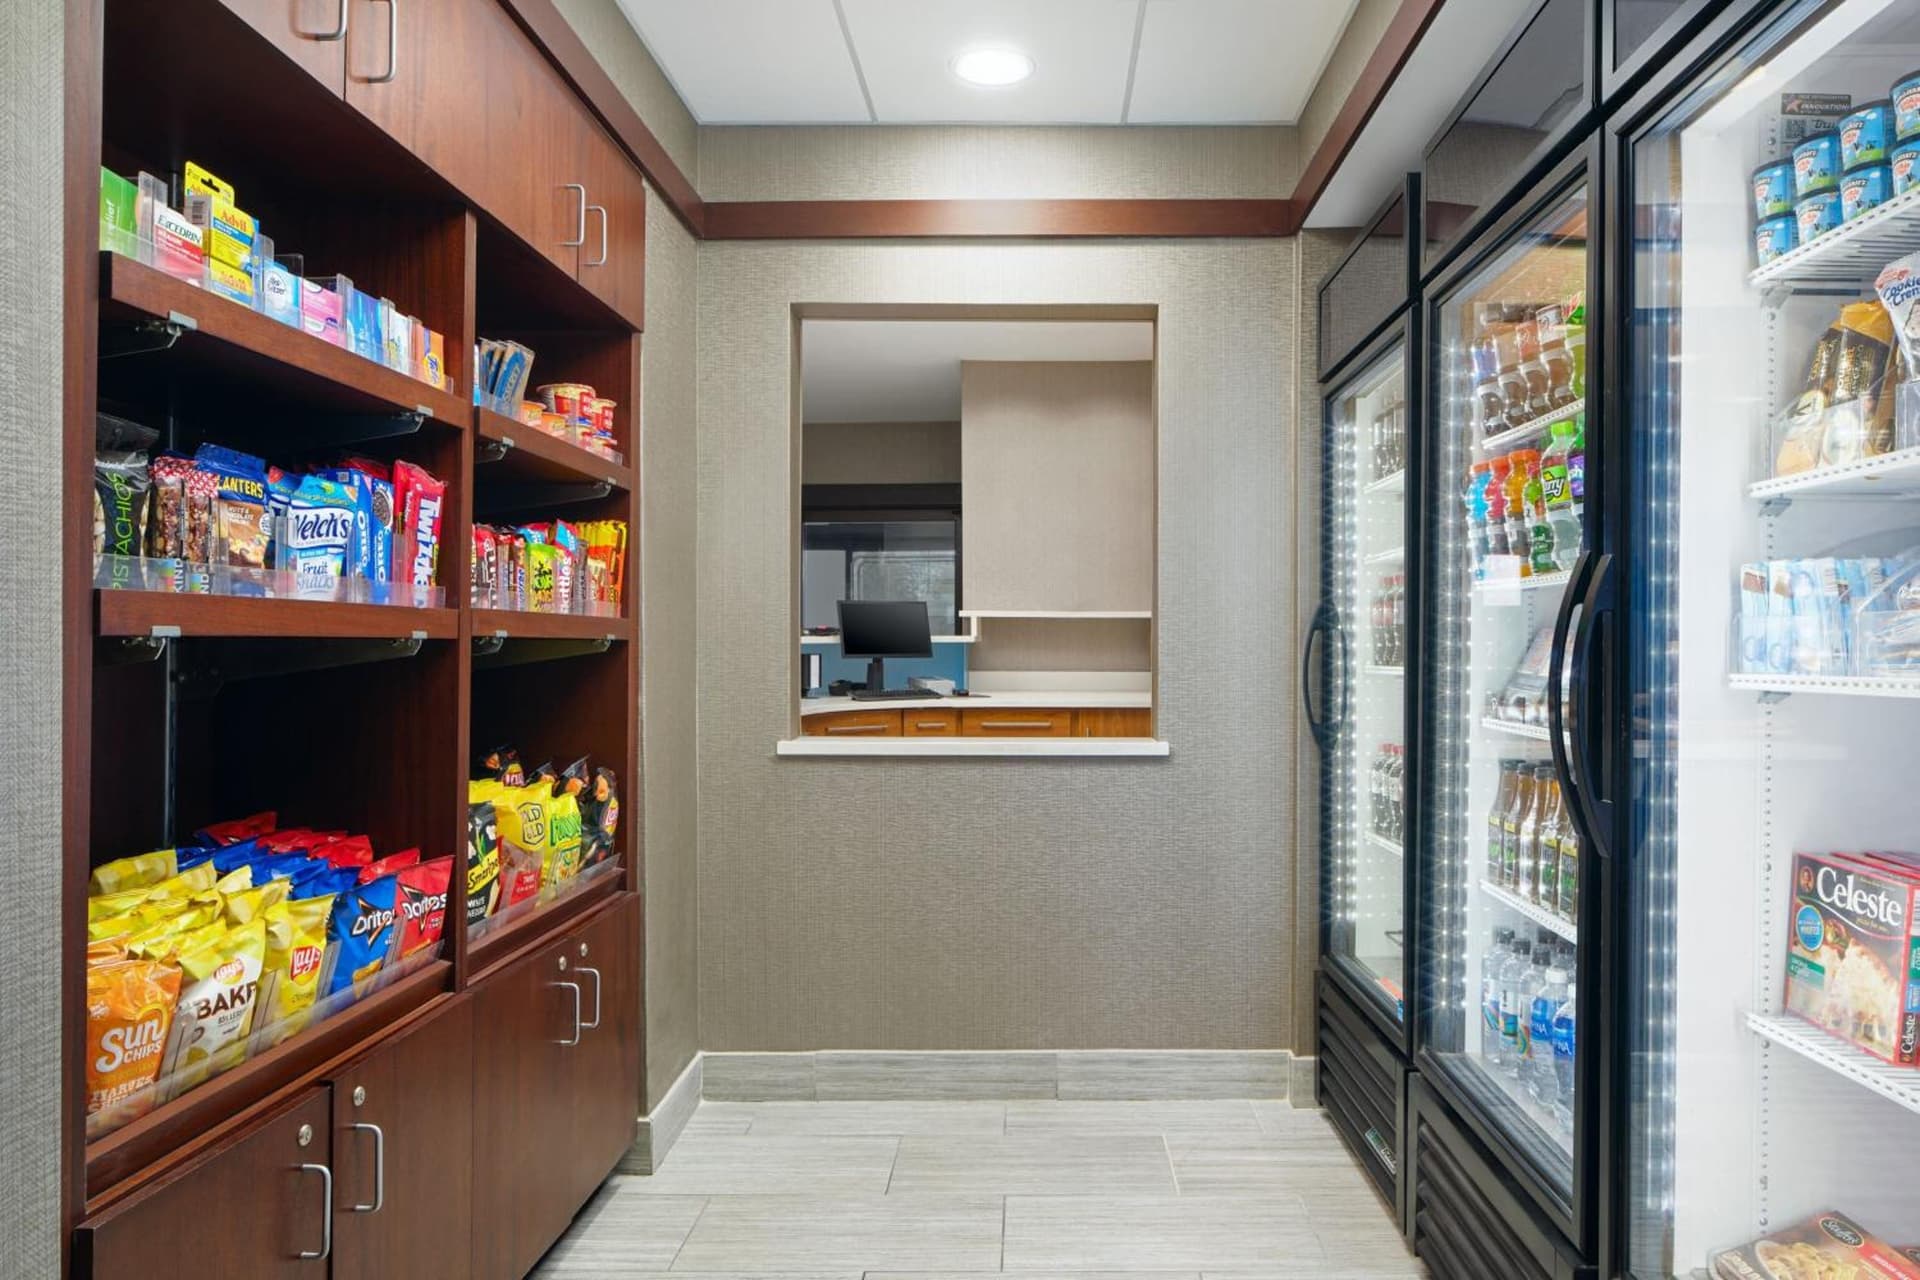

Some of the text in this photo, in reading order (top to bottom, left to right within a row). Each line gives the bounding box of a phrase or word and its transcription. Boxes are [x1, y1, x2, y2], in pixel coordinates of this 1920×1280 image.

[221, 209, 247, 233] Advil
[216, 474, 264, 499] LANTERS
[302, 560, 329, 576] Fruit
[1816, 866, 1903, 927] Celeste
[96, 1018, 162, 1073] Sun
[1901, 1014, 1916, 1054] Celeste
[123, 1041, 161, 1064] CHIPS
